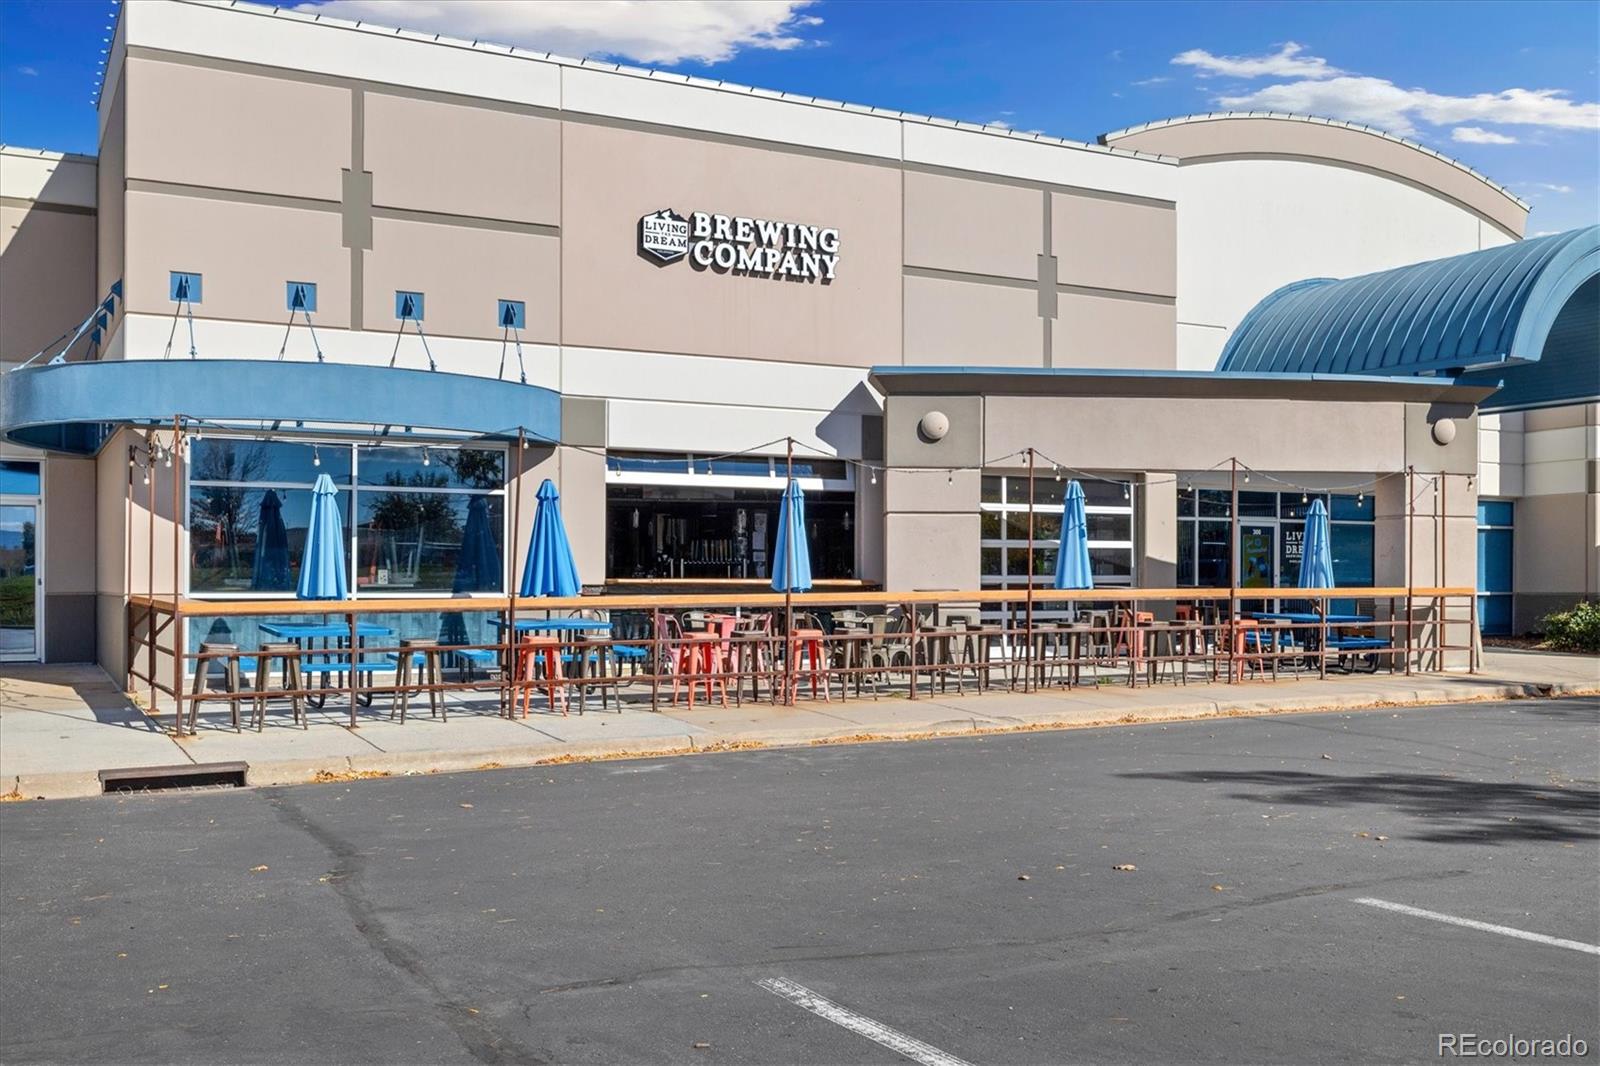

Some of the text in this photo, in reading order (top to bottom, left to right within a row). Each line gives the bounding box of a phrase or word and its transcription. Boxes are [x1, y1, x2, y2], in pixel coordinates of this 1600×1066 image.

[645, 221, 687, 234] LIVING
[694, 211, 839, 252] BREWING
[645, 234, 687, 247] DREAM
[694, 241, 840, 279] COMPANY
[1285, 531, 1305, 540] LIV
[1285, 545, 1304, 553] DRE
